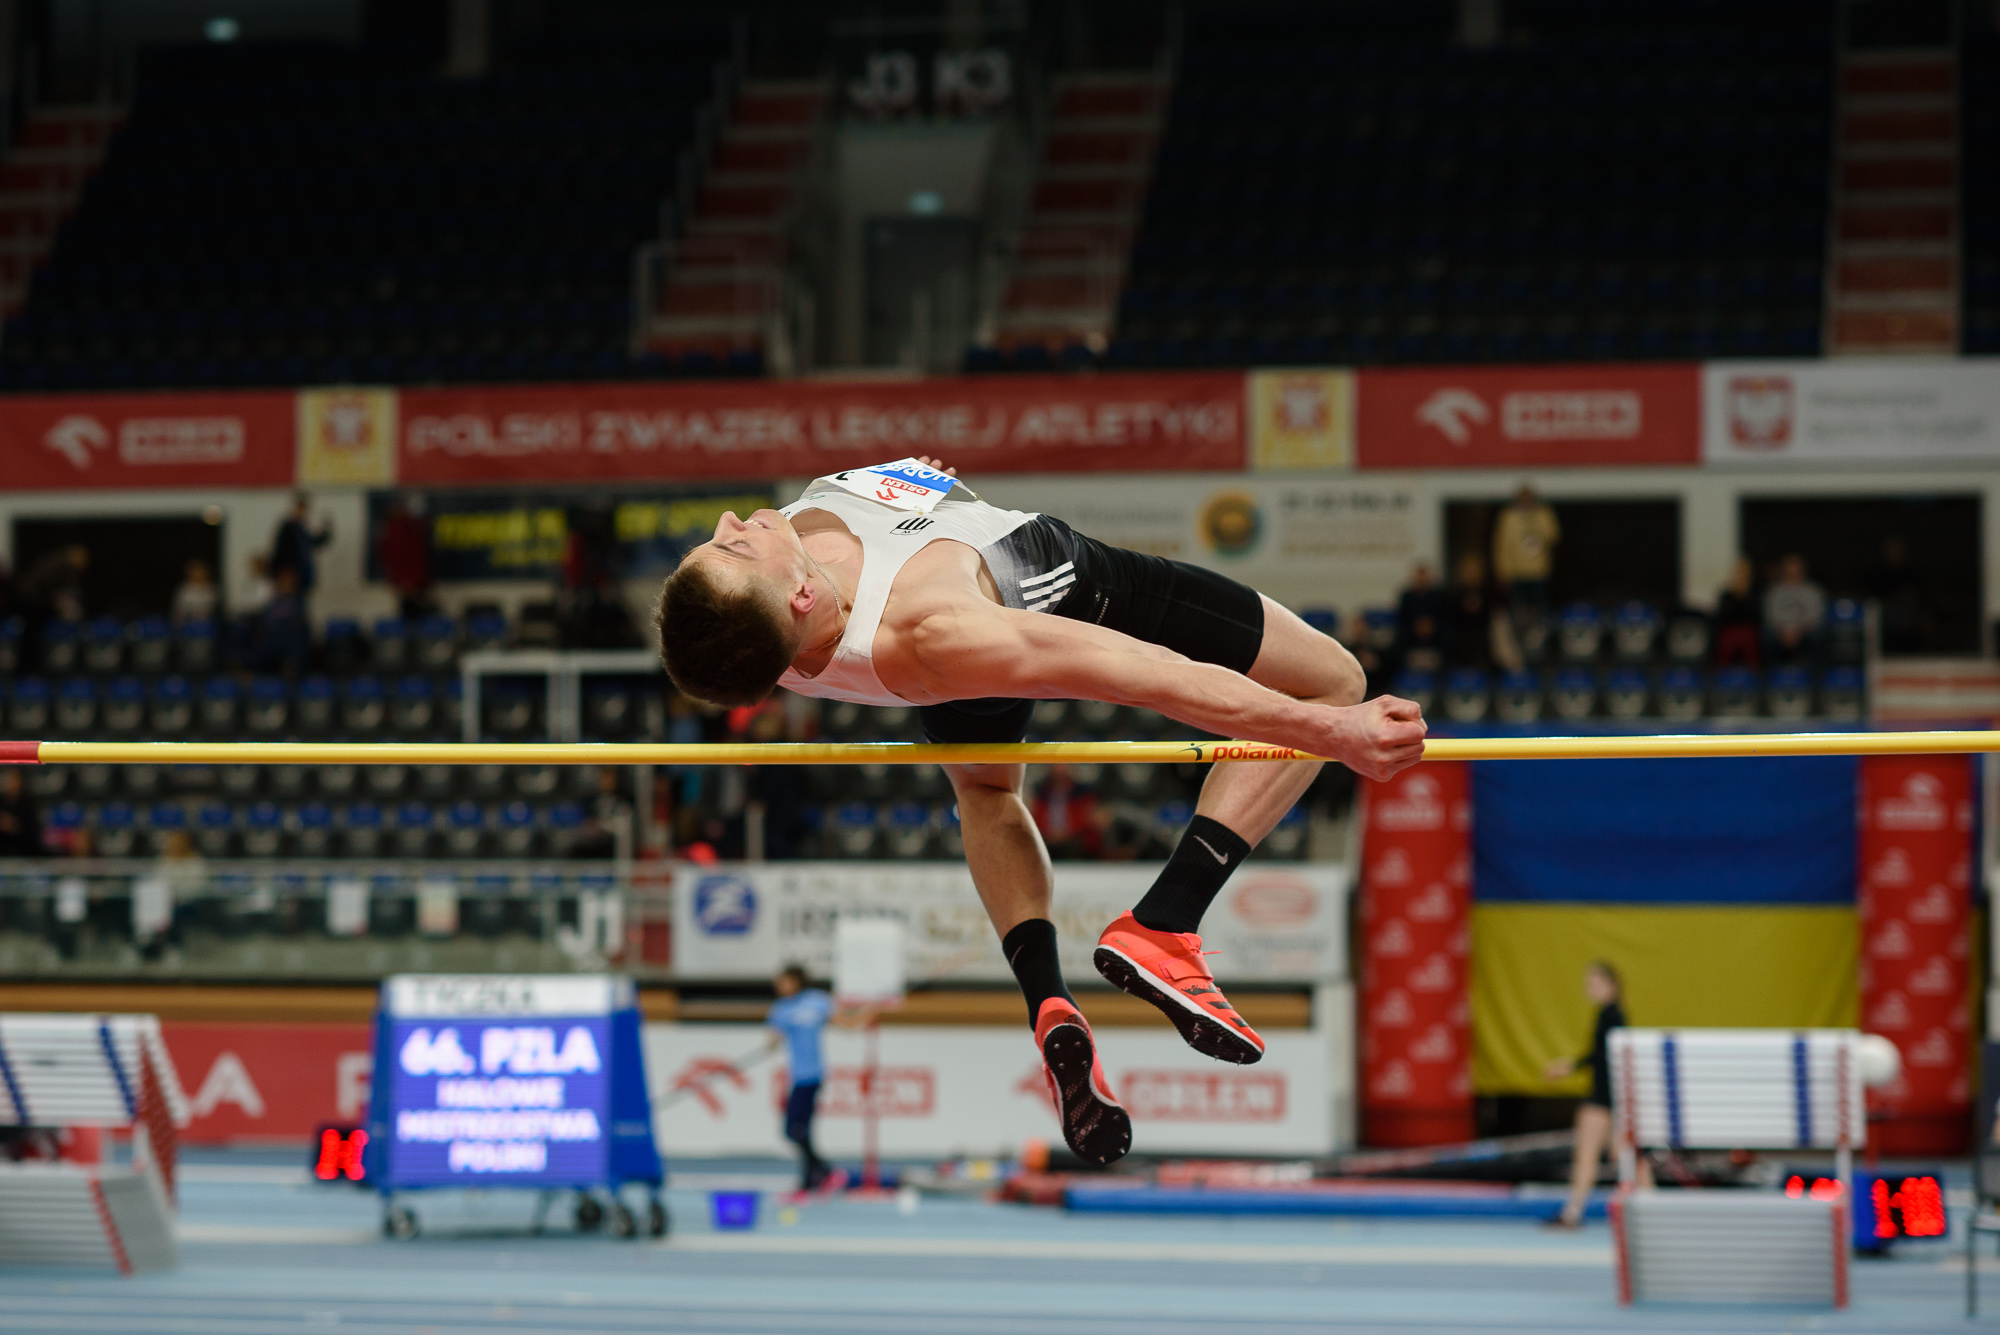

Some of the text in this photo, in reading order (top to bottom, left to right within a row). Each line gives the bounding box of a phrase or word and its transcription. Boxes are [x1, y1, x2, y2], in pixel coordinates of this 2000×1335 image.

[883, 479, 928, 495] ORLEN
[1211, 743, 1297, 762] polanik
[481, 1026, 600, 1074] PZLA
